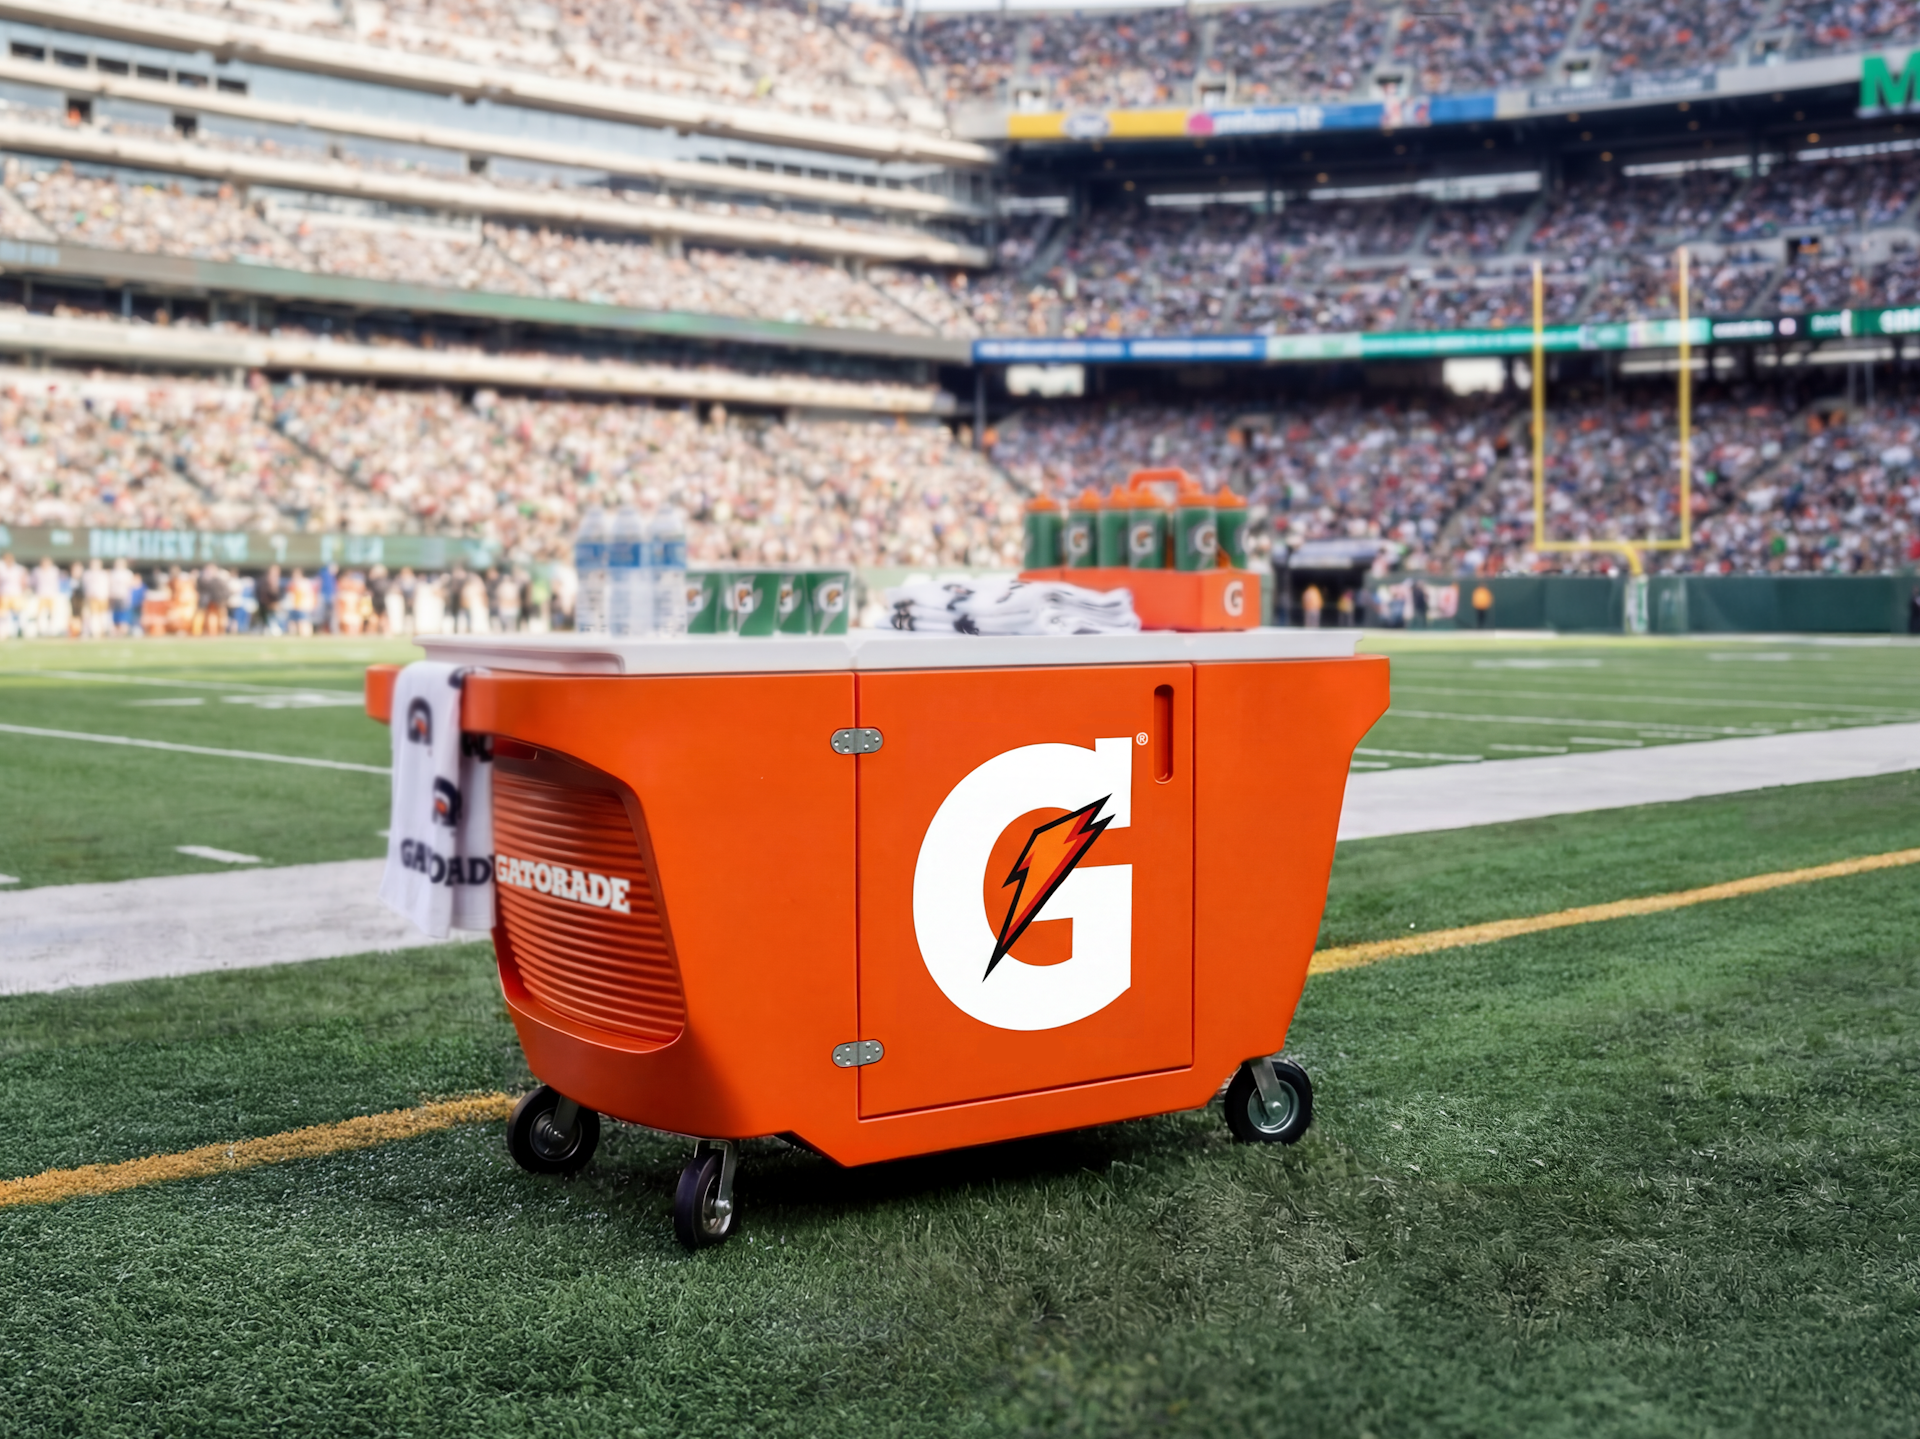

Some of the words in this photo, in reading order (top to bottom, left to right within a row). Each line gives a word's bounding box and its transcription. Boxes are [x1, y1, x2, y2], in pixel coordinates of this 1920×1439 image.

[1068, 528, 1089, 555] G
[1129, 525, 1156, 555] G
[818, 582, 845, 614] G
[1224, 581, 1244, 617] G
[495, 854, 631, 914] GATORADE
[913, 737, 1133, 1031] G
